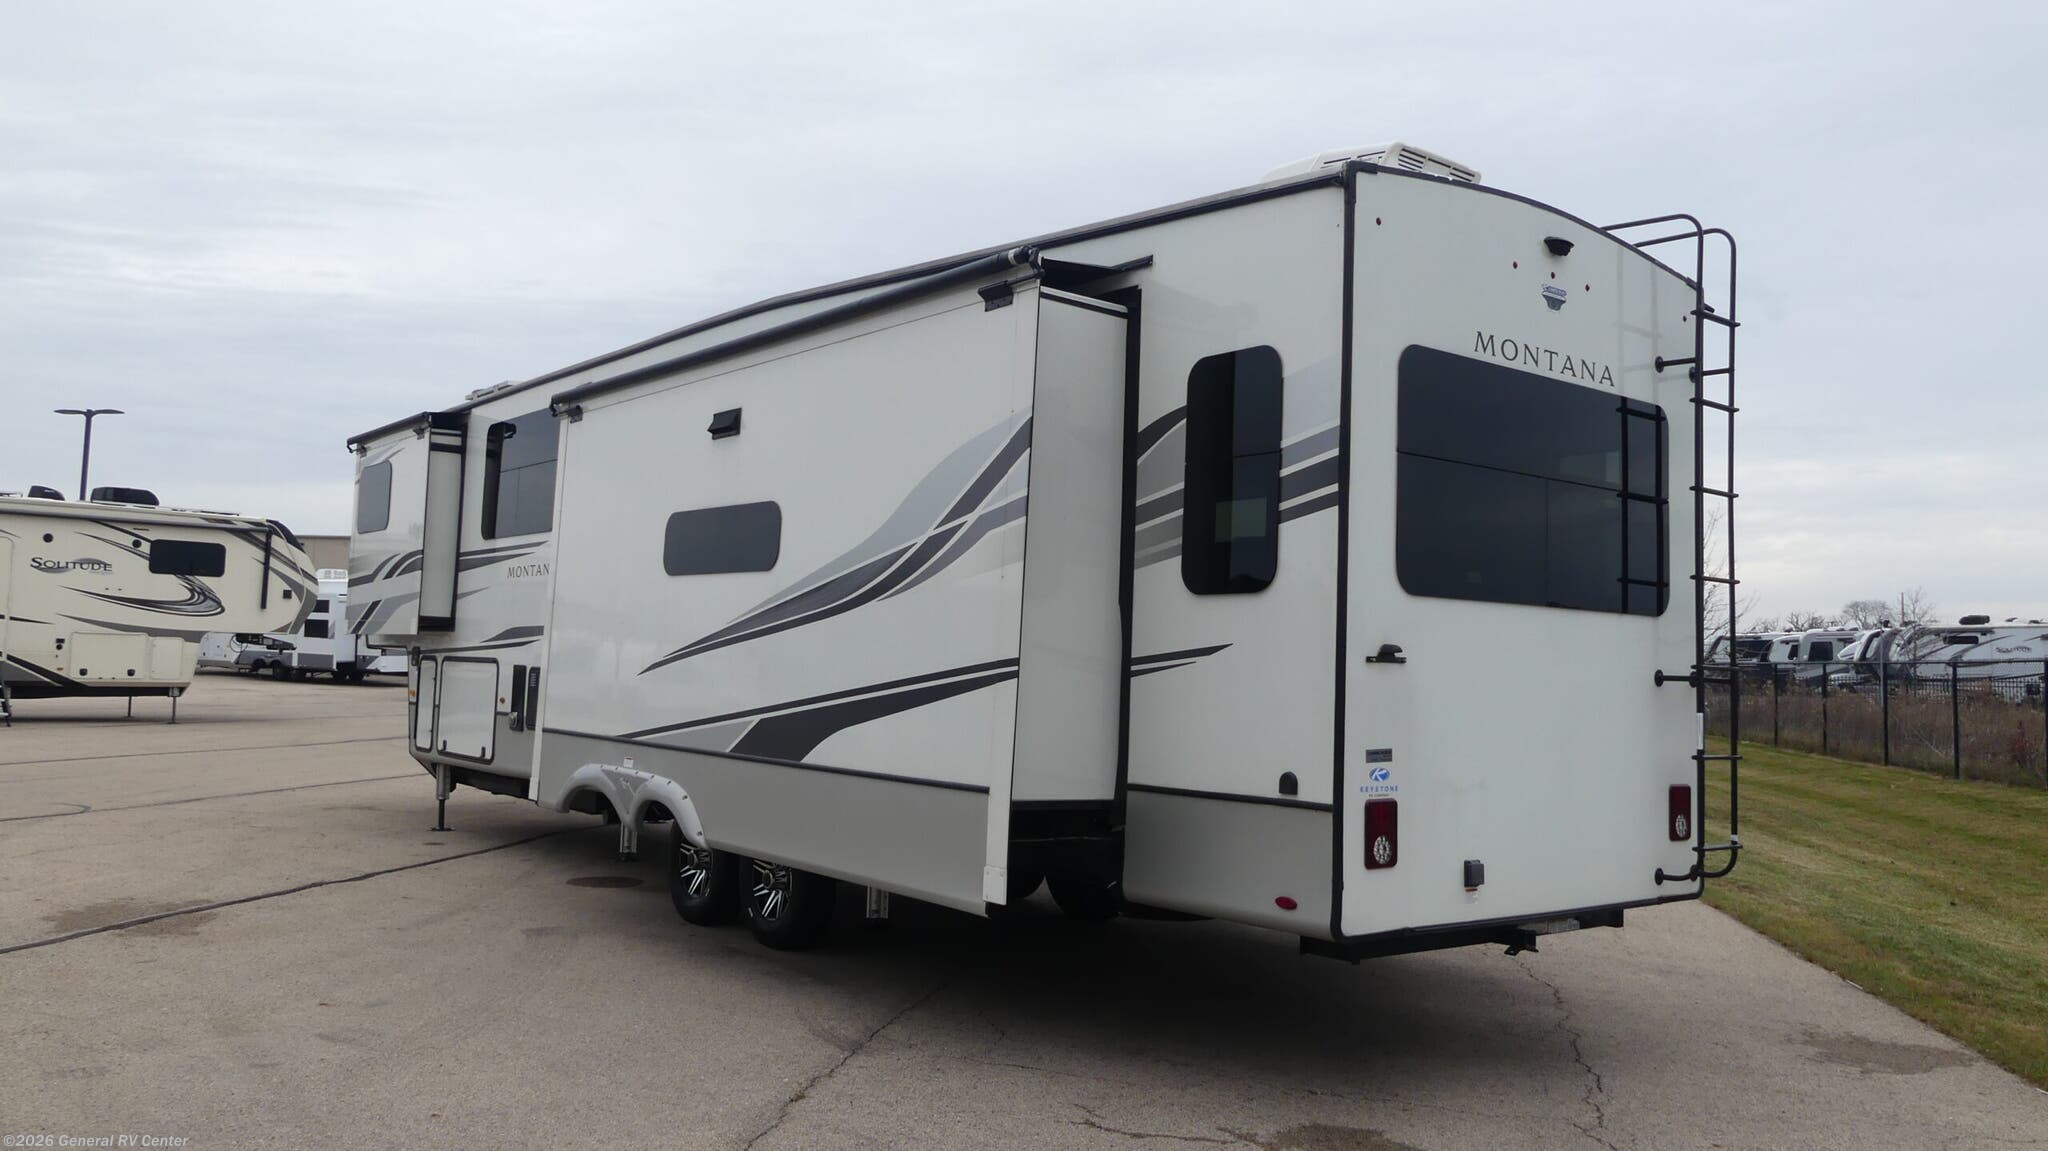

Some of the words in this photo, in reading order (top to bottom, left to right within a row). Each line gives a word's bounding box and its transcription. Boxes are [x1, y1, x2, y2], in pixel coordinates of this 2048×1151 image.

[1474, 331, 1615, 387] MONTANA
[30, 556, 113, 572] SOLITUDE
[1359, 785, 1399, 793] KEYSTONE
